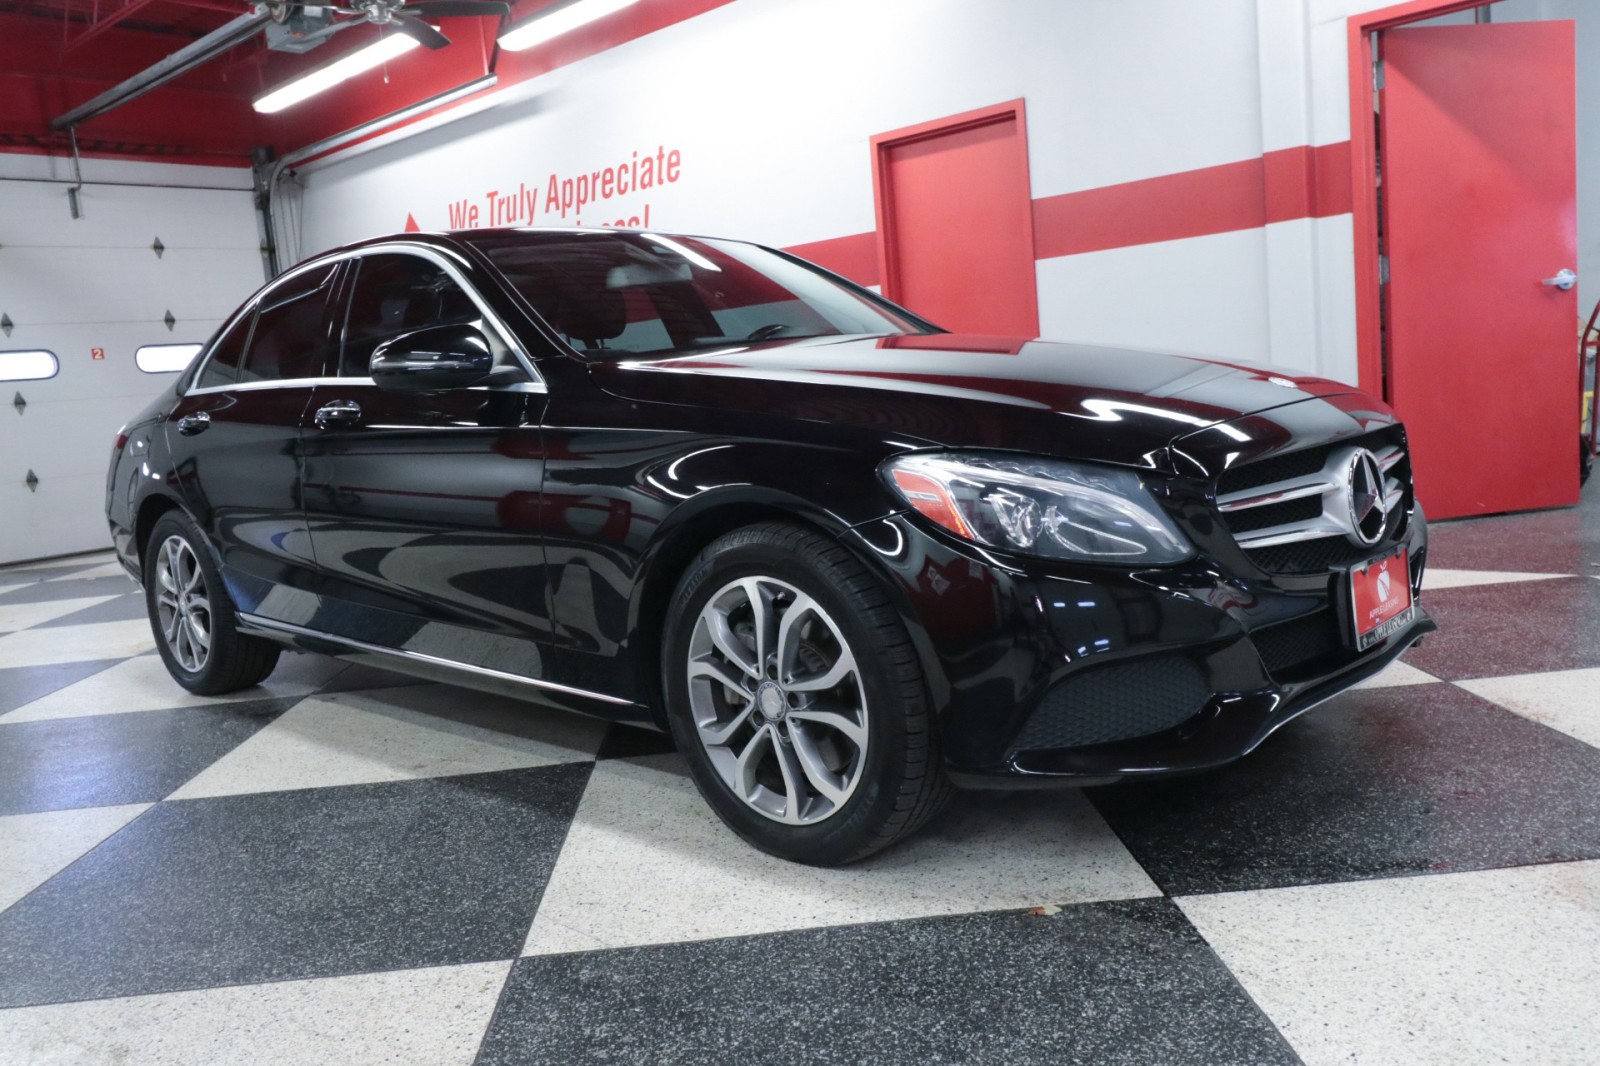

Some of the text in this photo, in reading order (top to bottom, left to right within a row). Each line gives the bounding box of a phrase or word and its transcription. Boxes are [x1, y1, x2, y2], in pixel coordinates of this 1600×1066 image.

[448, 199, 479, 229] We
[486, 183, 538, 226] Truly
[545, 145, 681, 219] Appreciate
[93, 349, 103, 360] 2
